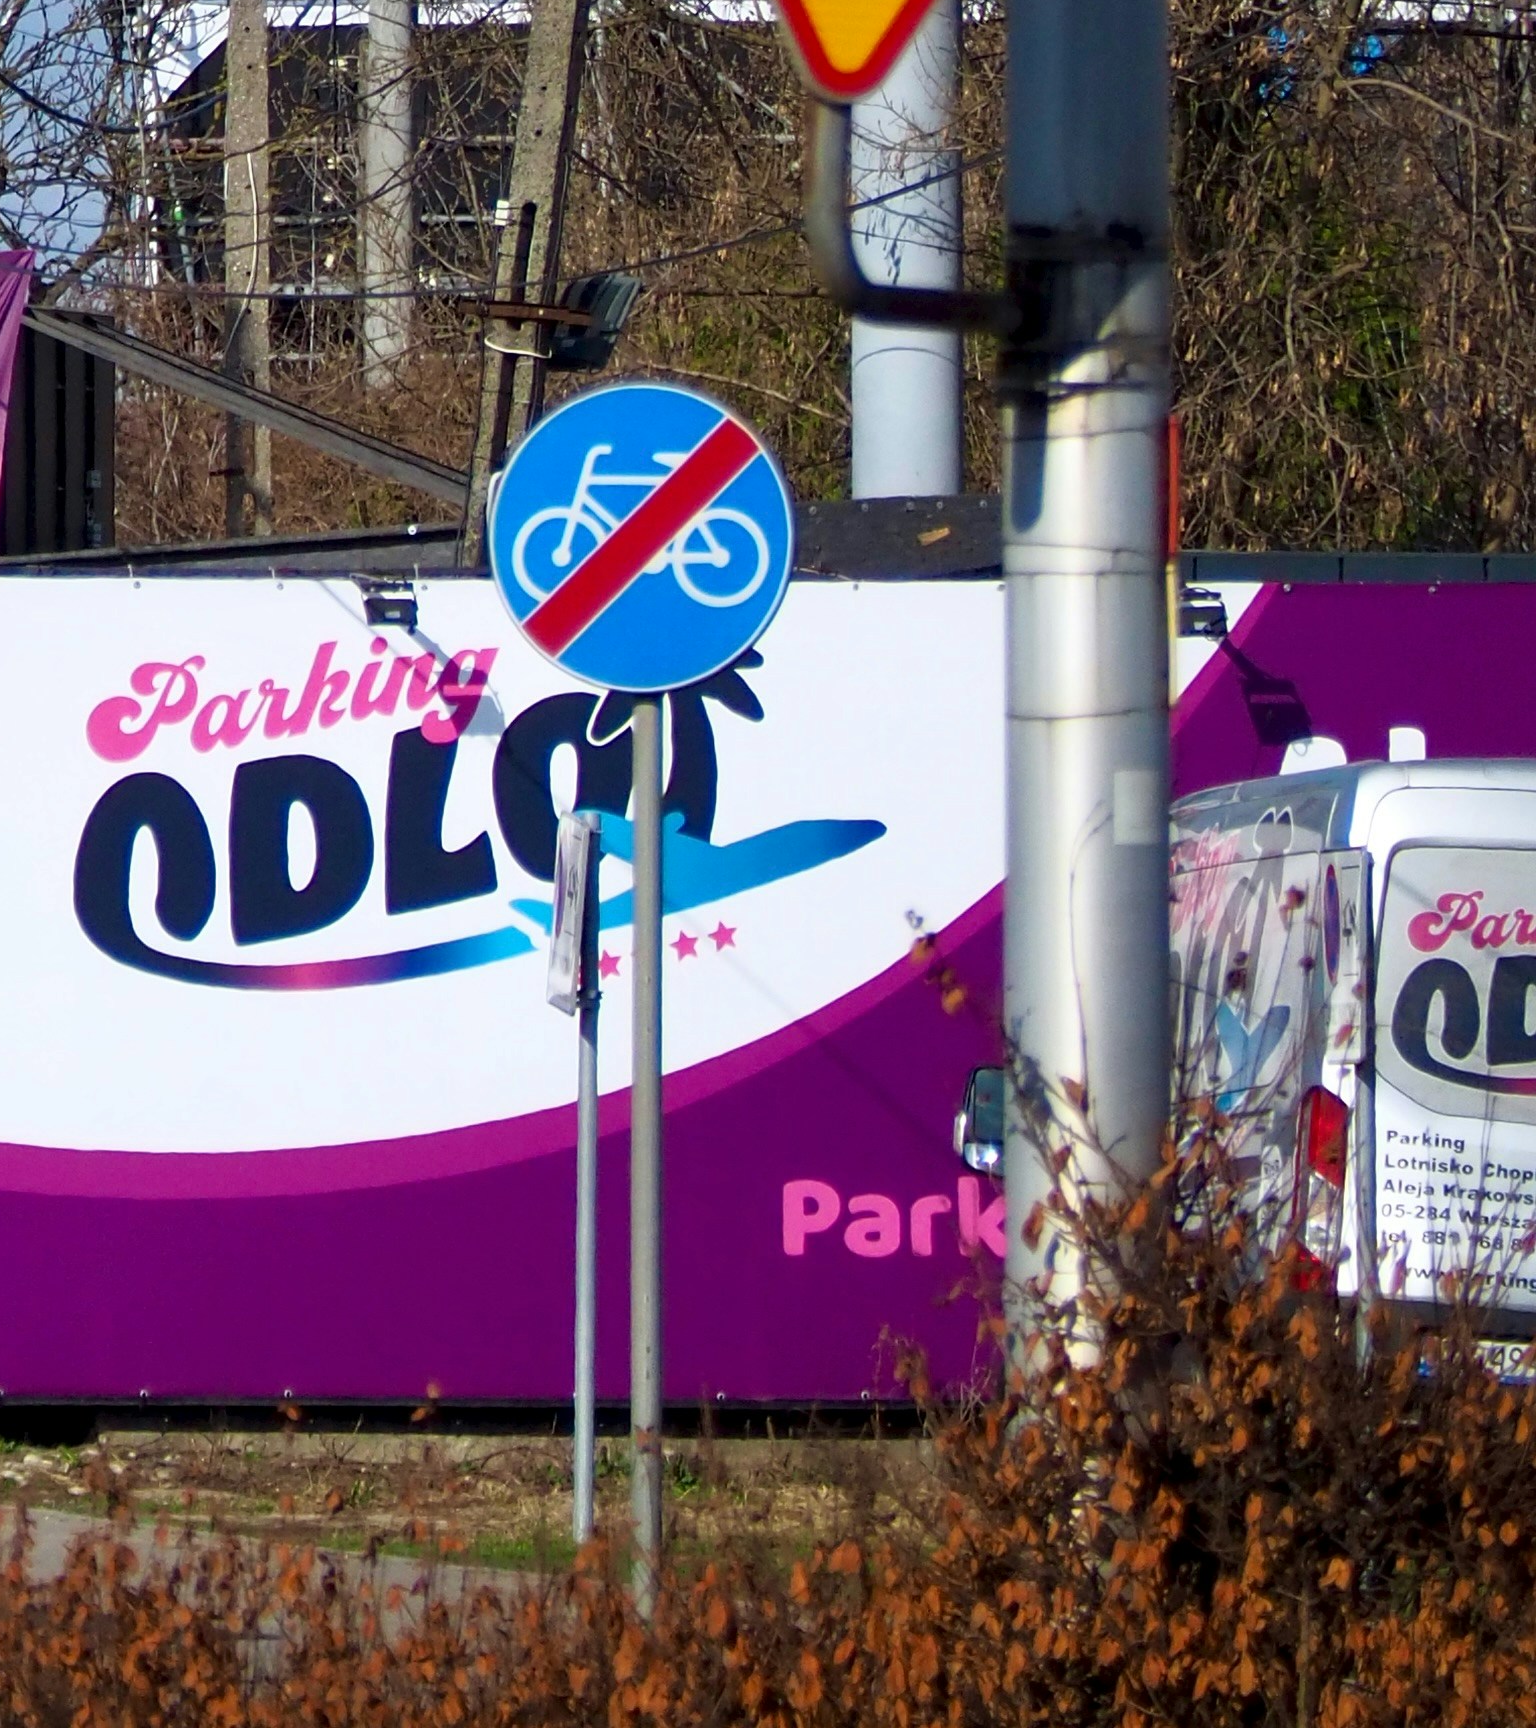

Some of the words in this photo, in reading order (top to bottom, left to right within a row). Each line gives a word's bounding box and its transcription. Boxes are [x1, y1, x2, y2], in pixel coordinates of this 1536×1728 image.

[85, 635, 500, 762] Parking
[1386, 1130, 1466, 1153] Parking
[1384, 1154, 1474, 1176] Lotnisko
[1483, 1162, 1536, 1182] Chop
[1383, 1179, 1435, 1199] Aleja
[1443, 1183, 1536, 1205] Krakows
